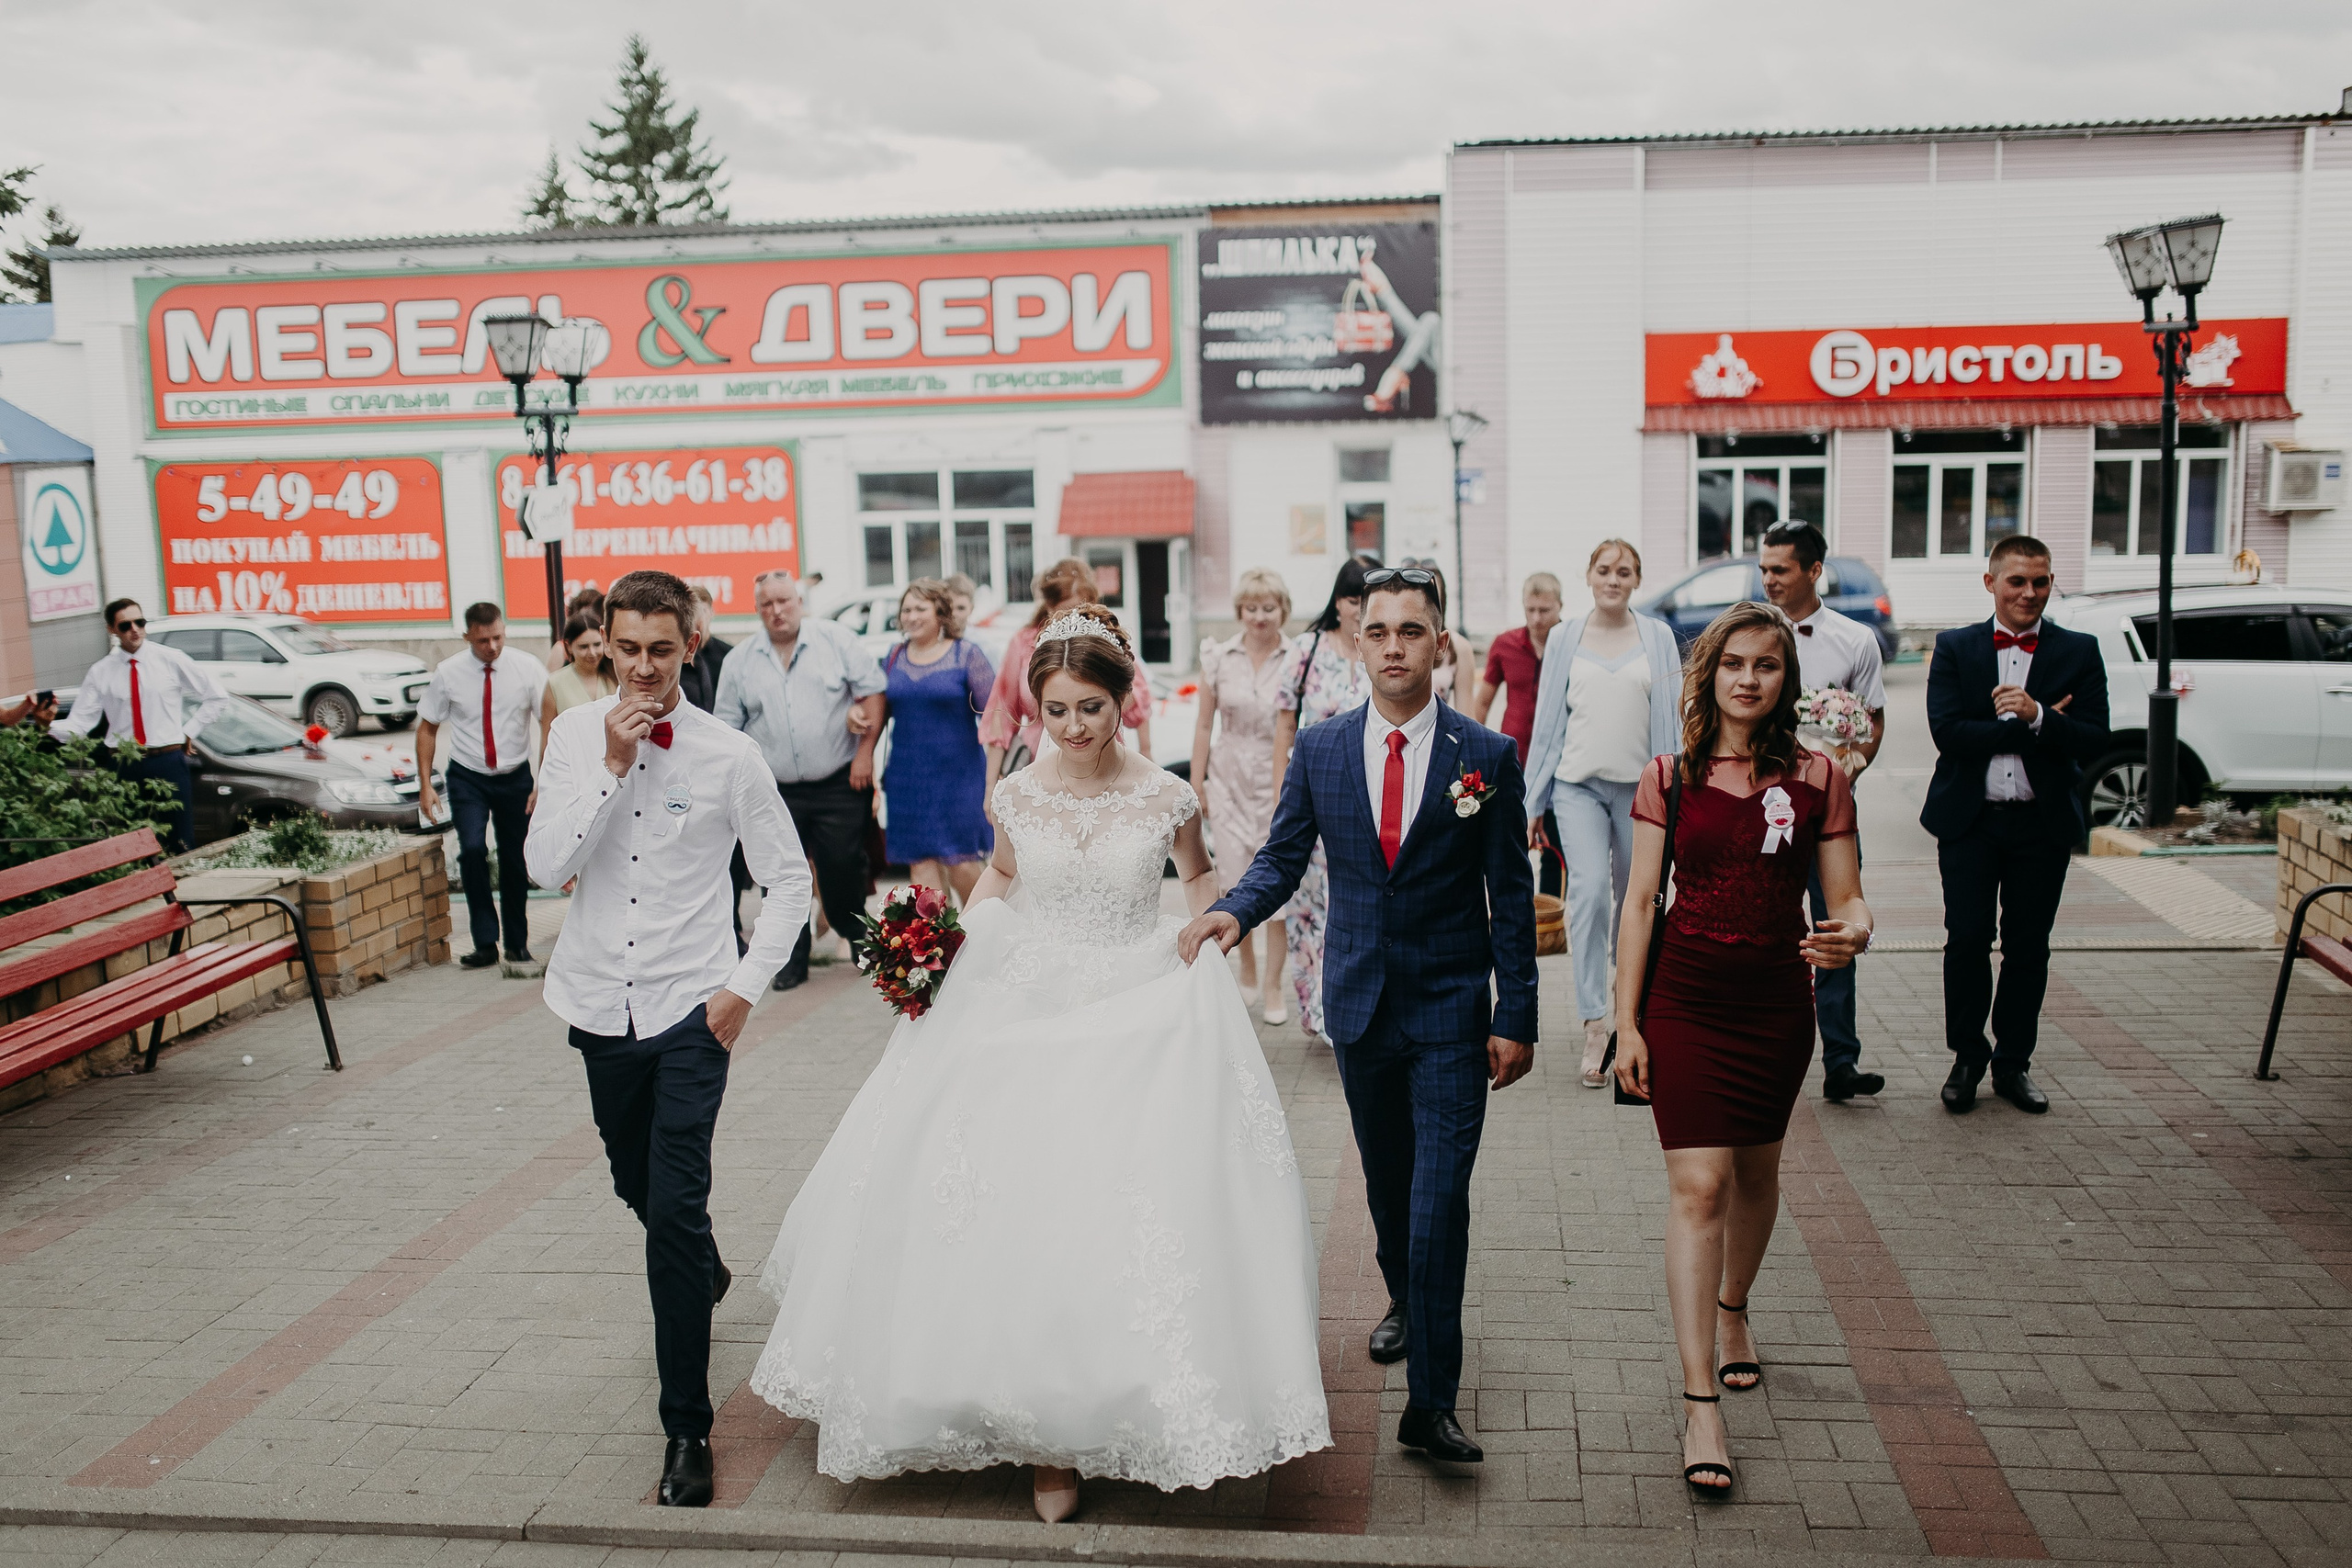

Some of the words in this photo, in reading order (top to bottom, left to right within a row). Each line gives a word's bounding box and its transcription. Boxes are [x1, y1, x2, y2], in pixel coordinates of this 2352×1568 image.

[164, 295, 611, 383] МЕБЕЛЬ
[637, 275, 731, 367] &
[751, 270, 1153, 365] ДВЕРИ
[1810, 329, 2123, 398] Бристоль
[175, 396, 307, 415] ГОСТИНЫЕ
[331, 392, 449, 412] СПАЛЬНИ
[615, 383, 699, 400] КУХНИ
[725, 379, 829, 397] МЯГКАЯ
[841, 375, 946, 393] МЕБЕЛЬ
[196, 469, 400, 523] 5-49-49
[170, 530, 311, 564] ПОКУПАЙ
[318, 533, 441, 561] МЕБЕЛЬ
[173, 586, 217, 613] НА
[216, 570, 293, 613] 10%
[295, 581, 447, 615] ДЕШЕВЛЕ
